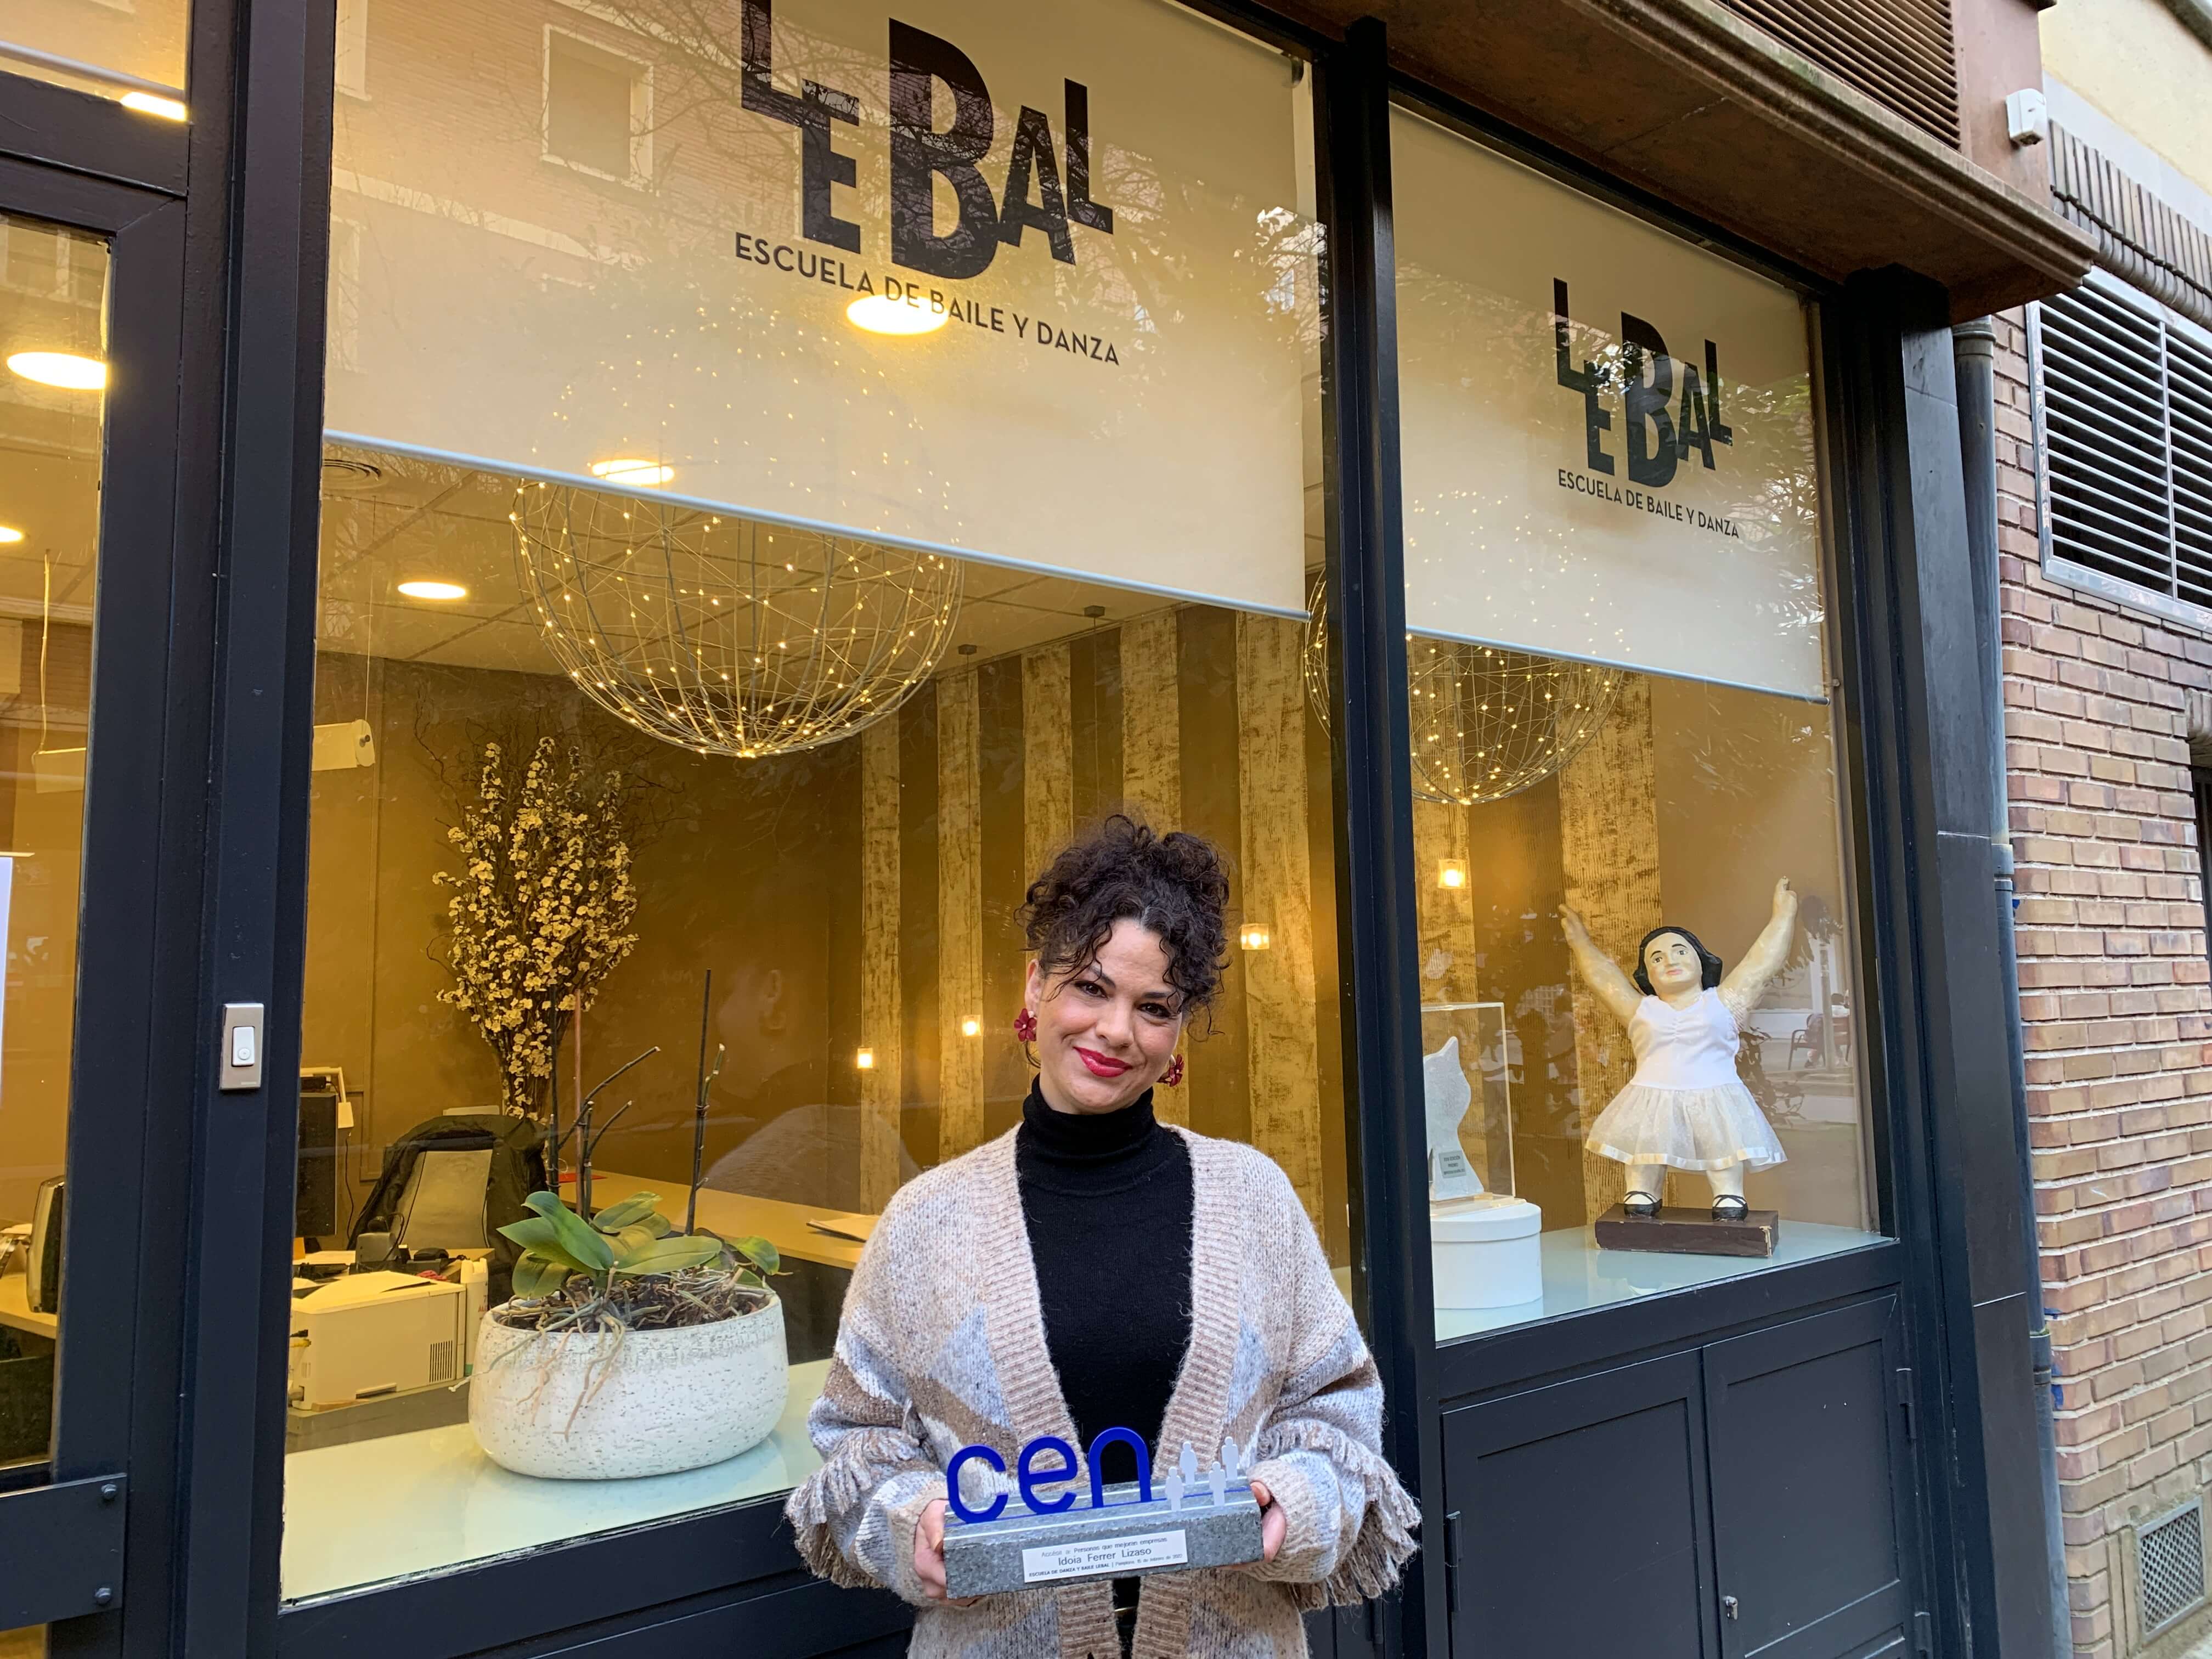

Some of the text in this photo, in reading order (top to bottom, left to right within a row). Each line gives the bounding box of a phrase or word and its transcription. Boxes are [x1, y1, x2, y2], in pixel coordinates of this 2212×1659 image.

[735, 231, 1120, 366] ESCUELA DE BAILE Y DANZA
[1558, 468, 1740, 539] ESCUELA DE BAILE Y DANZA
[947, 1427, 1153, 1524] cen
[1058, 1548, 1152, 1566] Idoia Ferrer Lizaso
